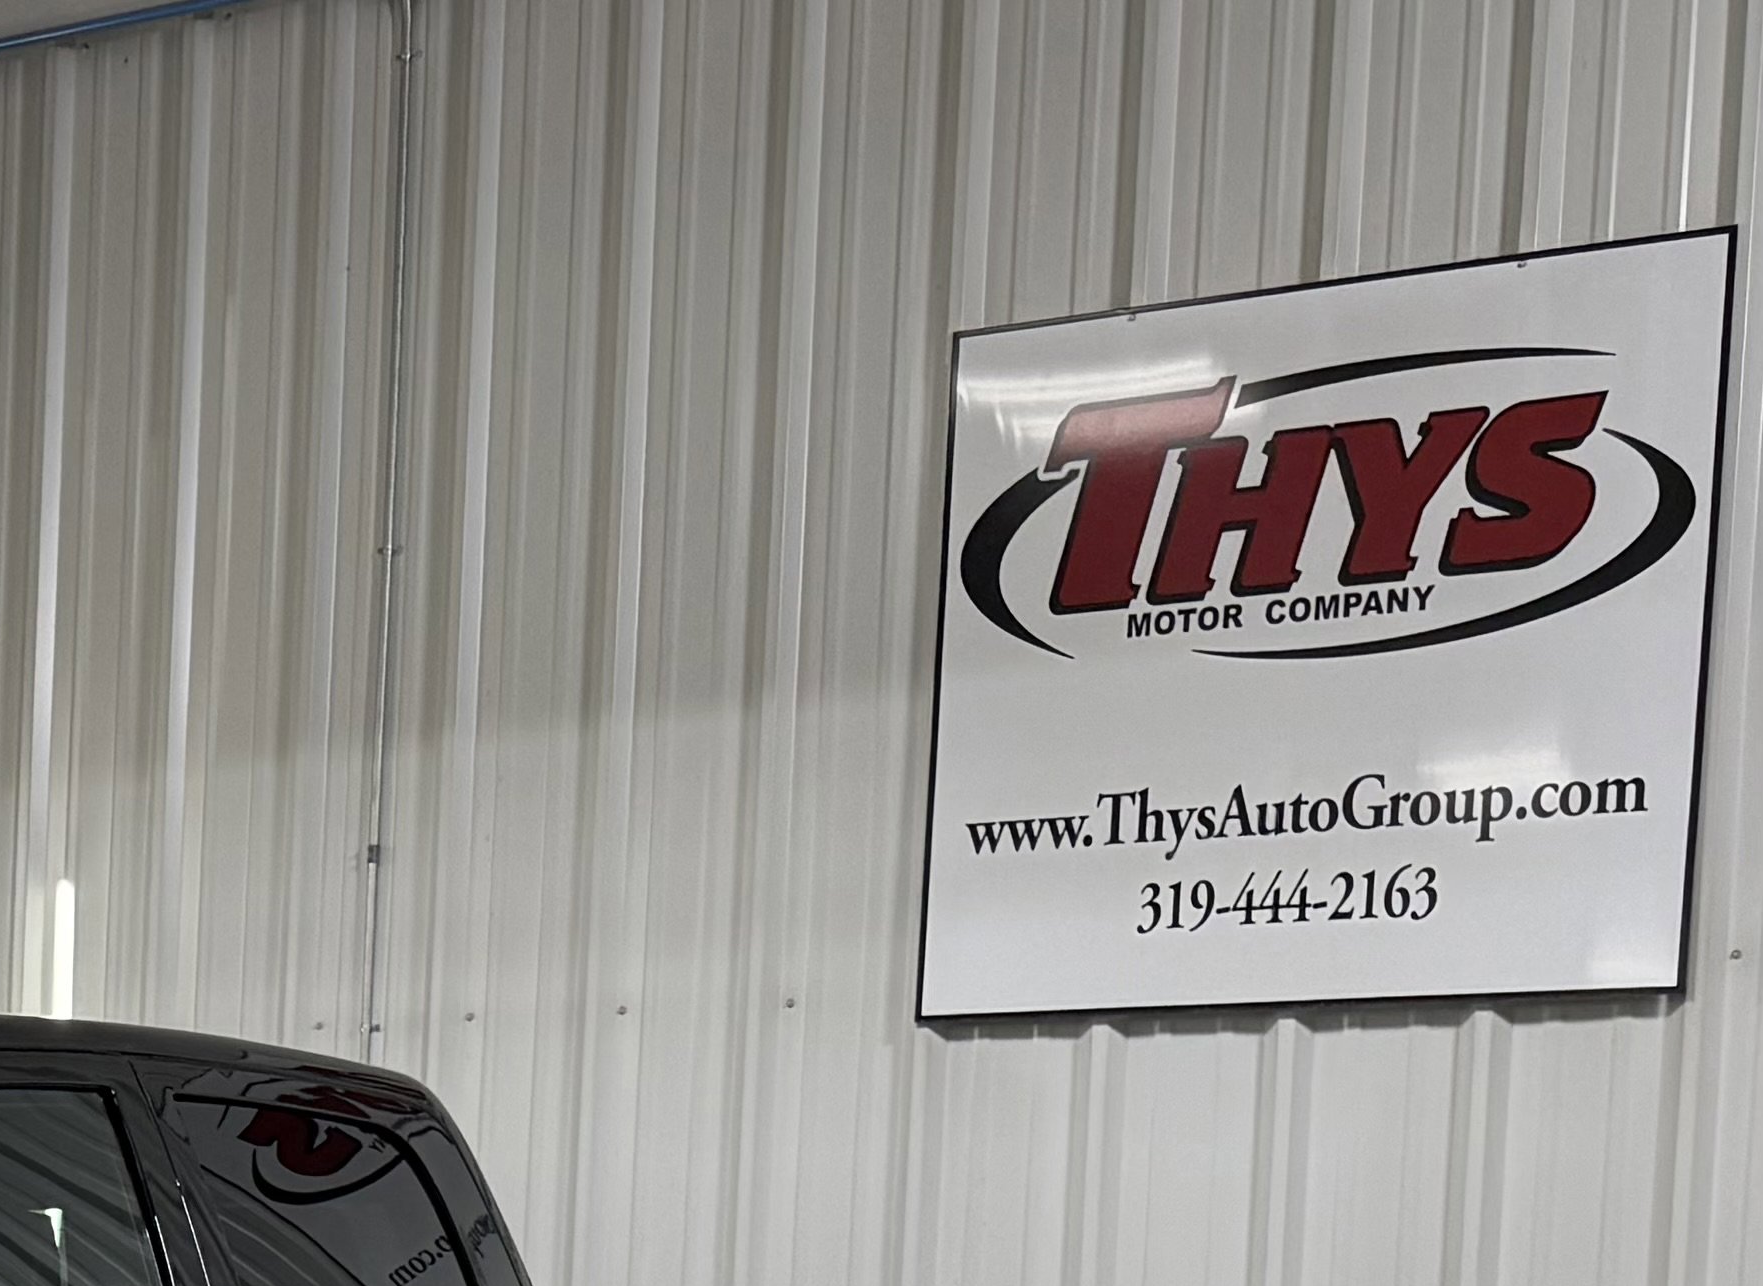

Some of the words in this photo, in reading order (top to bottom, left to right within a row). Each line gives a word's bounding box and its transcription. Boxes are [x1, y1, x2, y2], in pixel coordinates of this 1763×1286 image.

[1125, 602, 1243, 639] MOTOR
[1265, 584, 1435, 626] COMPANY
[965, 772, 1649, 860] www.ThysAutoGroup.com
[1136, 864, 1439, 934] 319-444-2163
